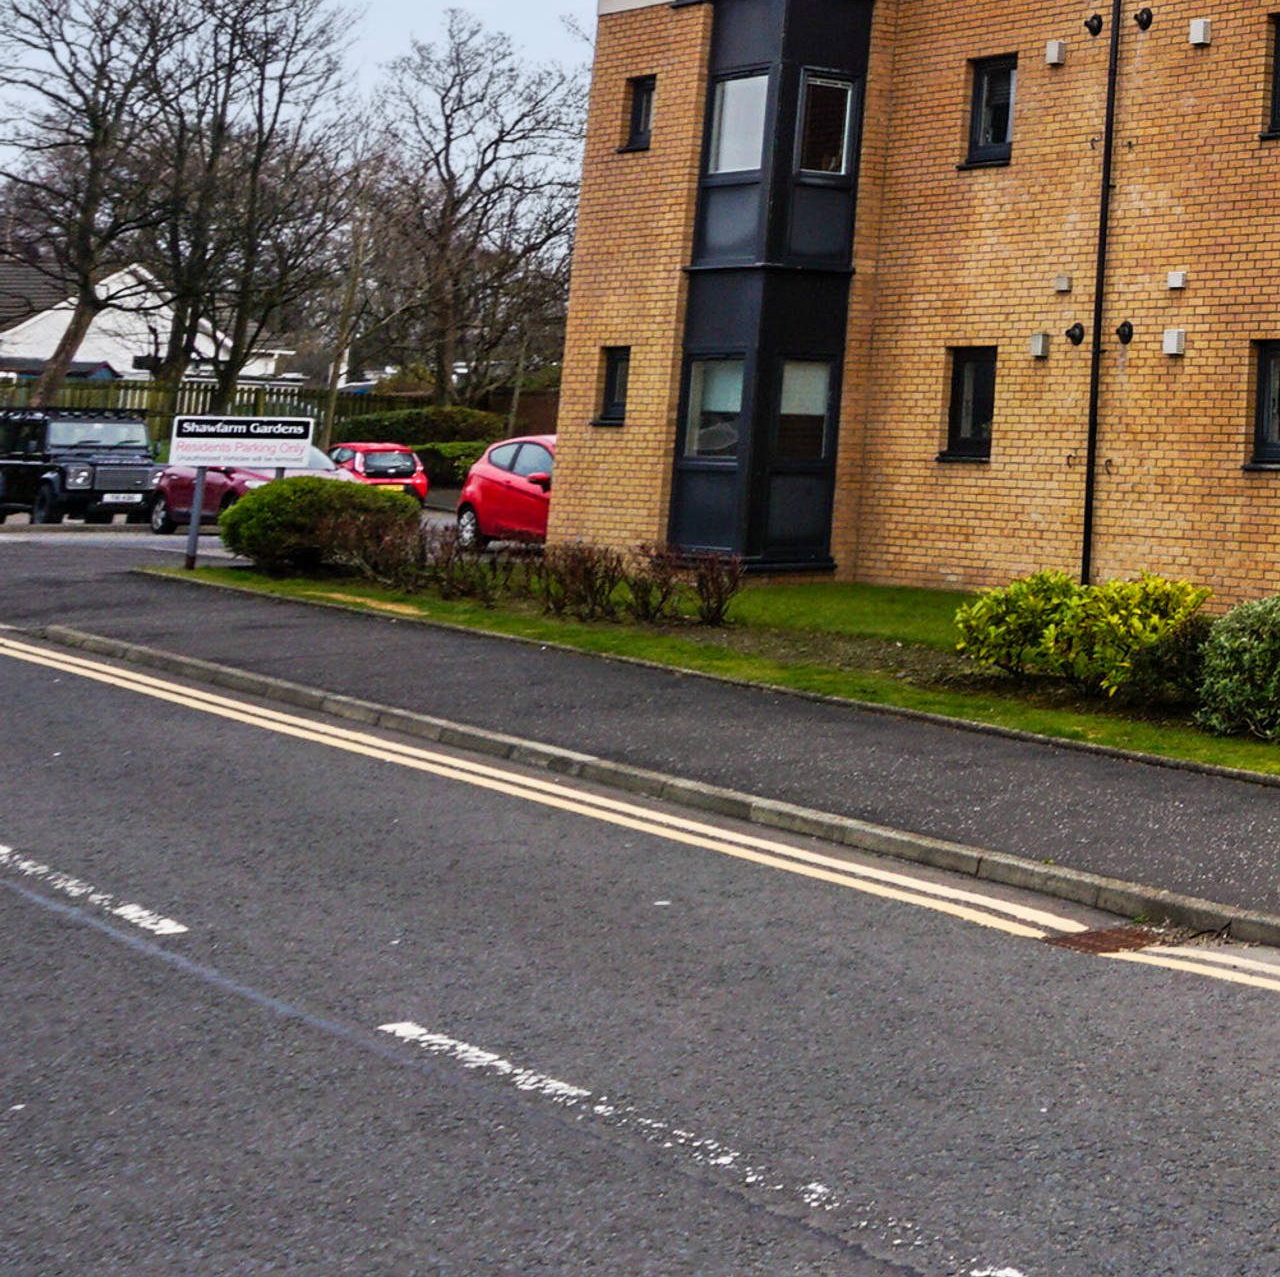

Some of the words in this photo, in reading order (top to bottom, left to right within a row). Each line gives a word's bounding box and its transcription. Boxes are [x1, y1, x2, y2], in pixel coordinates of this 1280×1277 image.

[182, 422, 247, 433] Shawfarm
[249, 423, 305, 434] Gardens
[175, 441, 231, 453] Residents
[235, 441, 277, 456] Parking
[279, 442, 306, 456] Only
